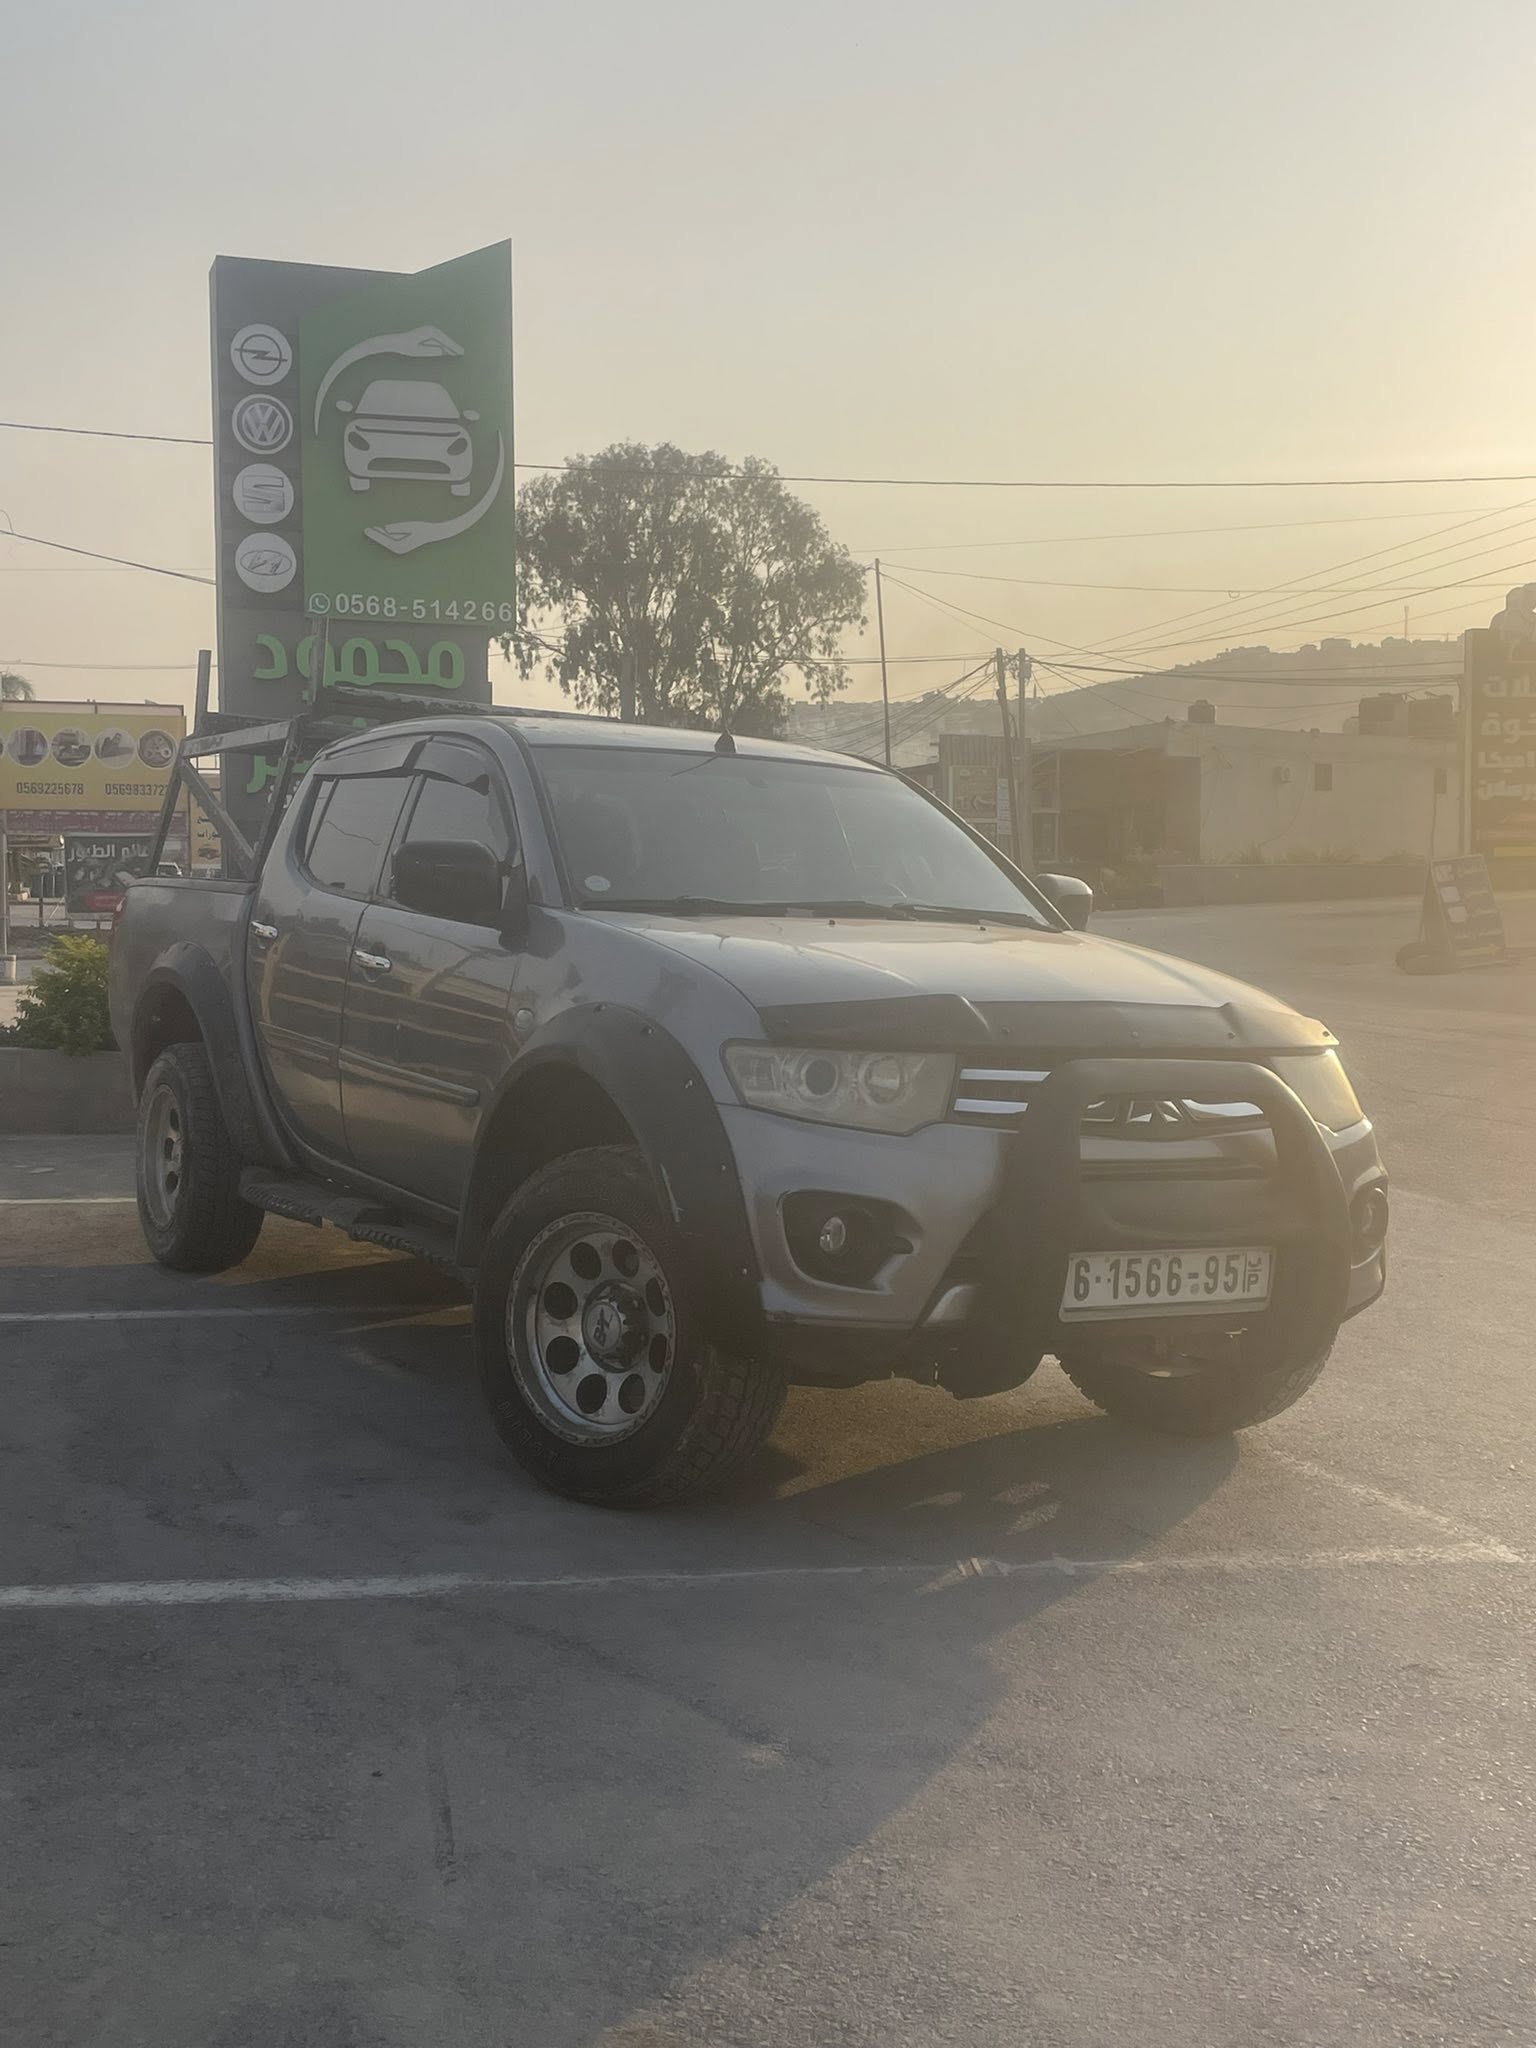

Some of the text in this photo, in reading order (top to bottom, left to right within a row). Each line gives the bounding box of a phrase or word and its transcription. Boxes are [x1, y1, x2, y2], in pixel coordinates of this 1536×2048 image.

[335, 593, 513, 622] 0568-514266
[253, 634, 465, 689] محمود
[16, 781, 169, 796] 0569225678 056983372
